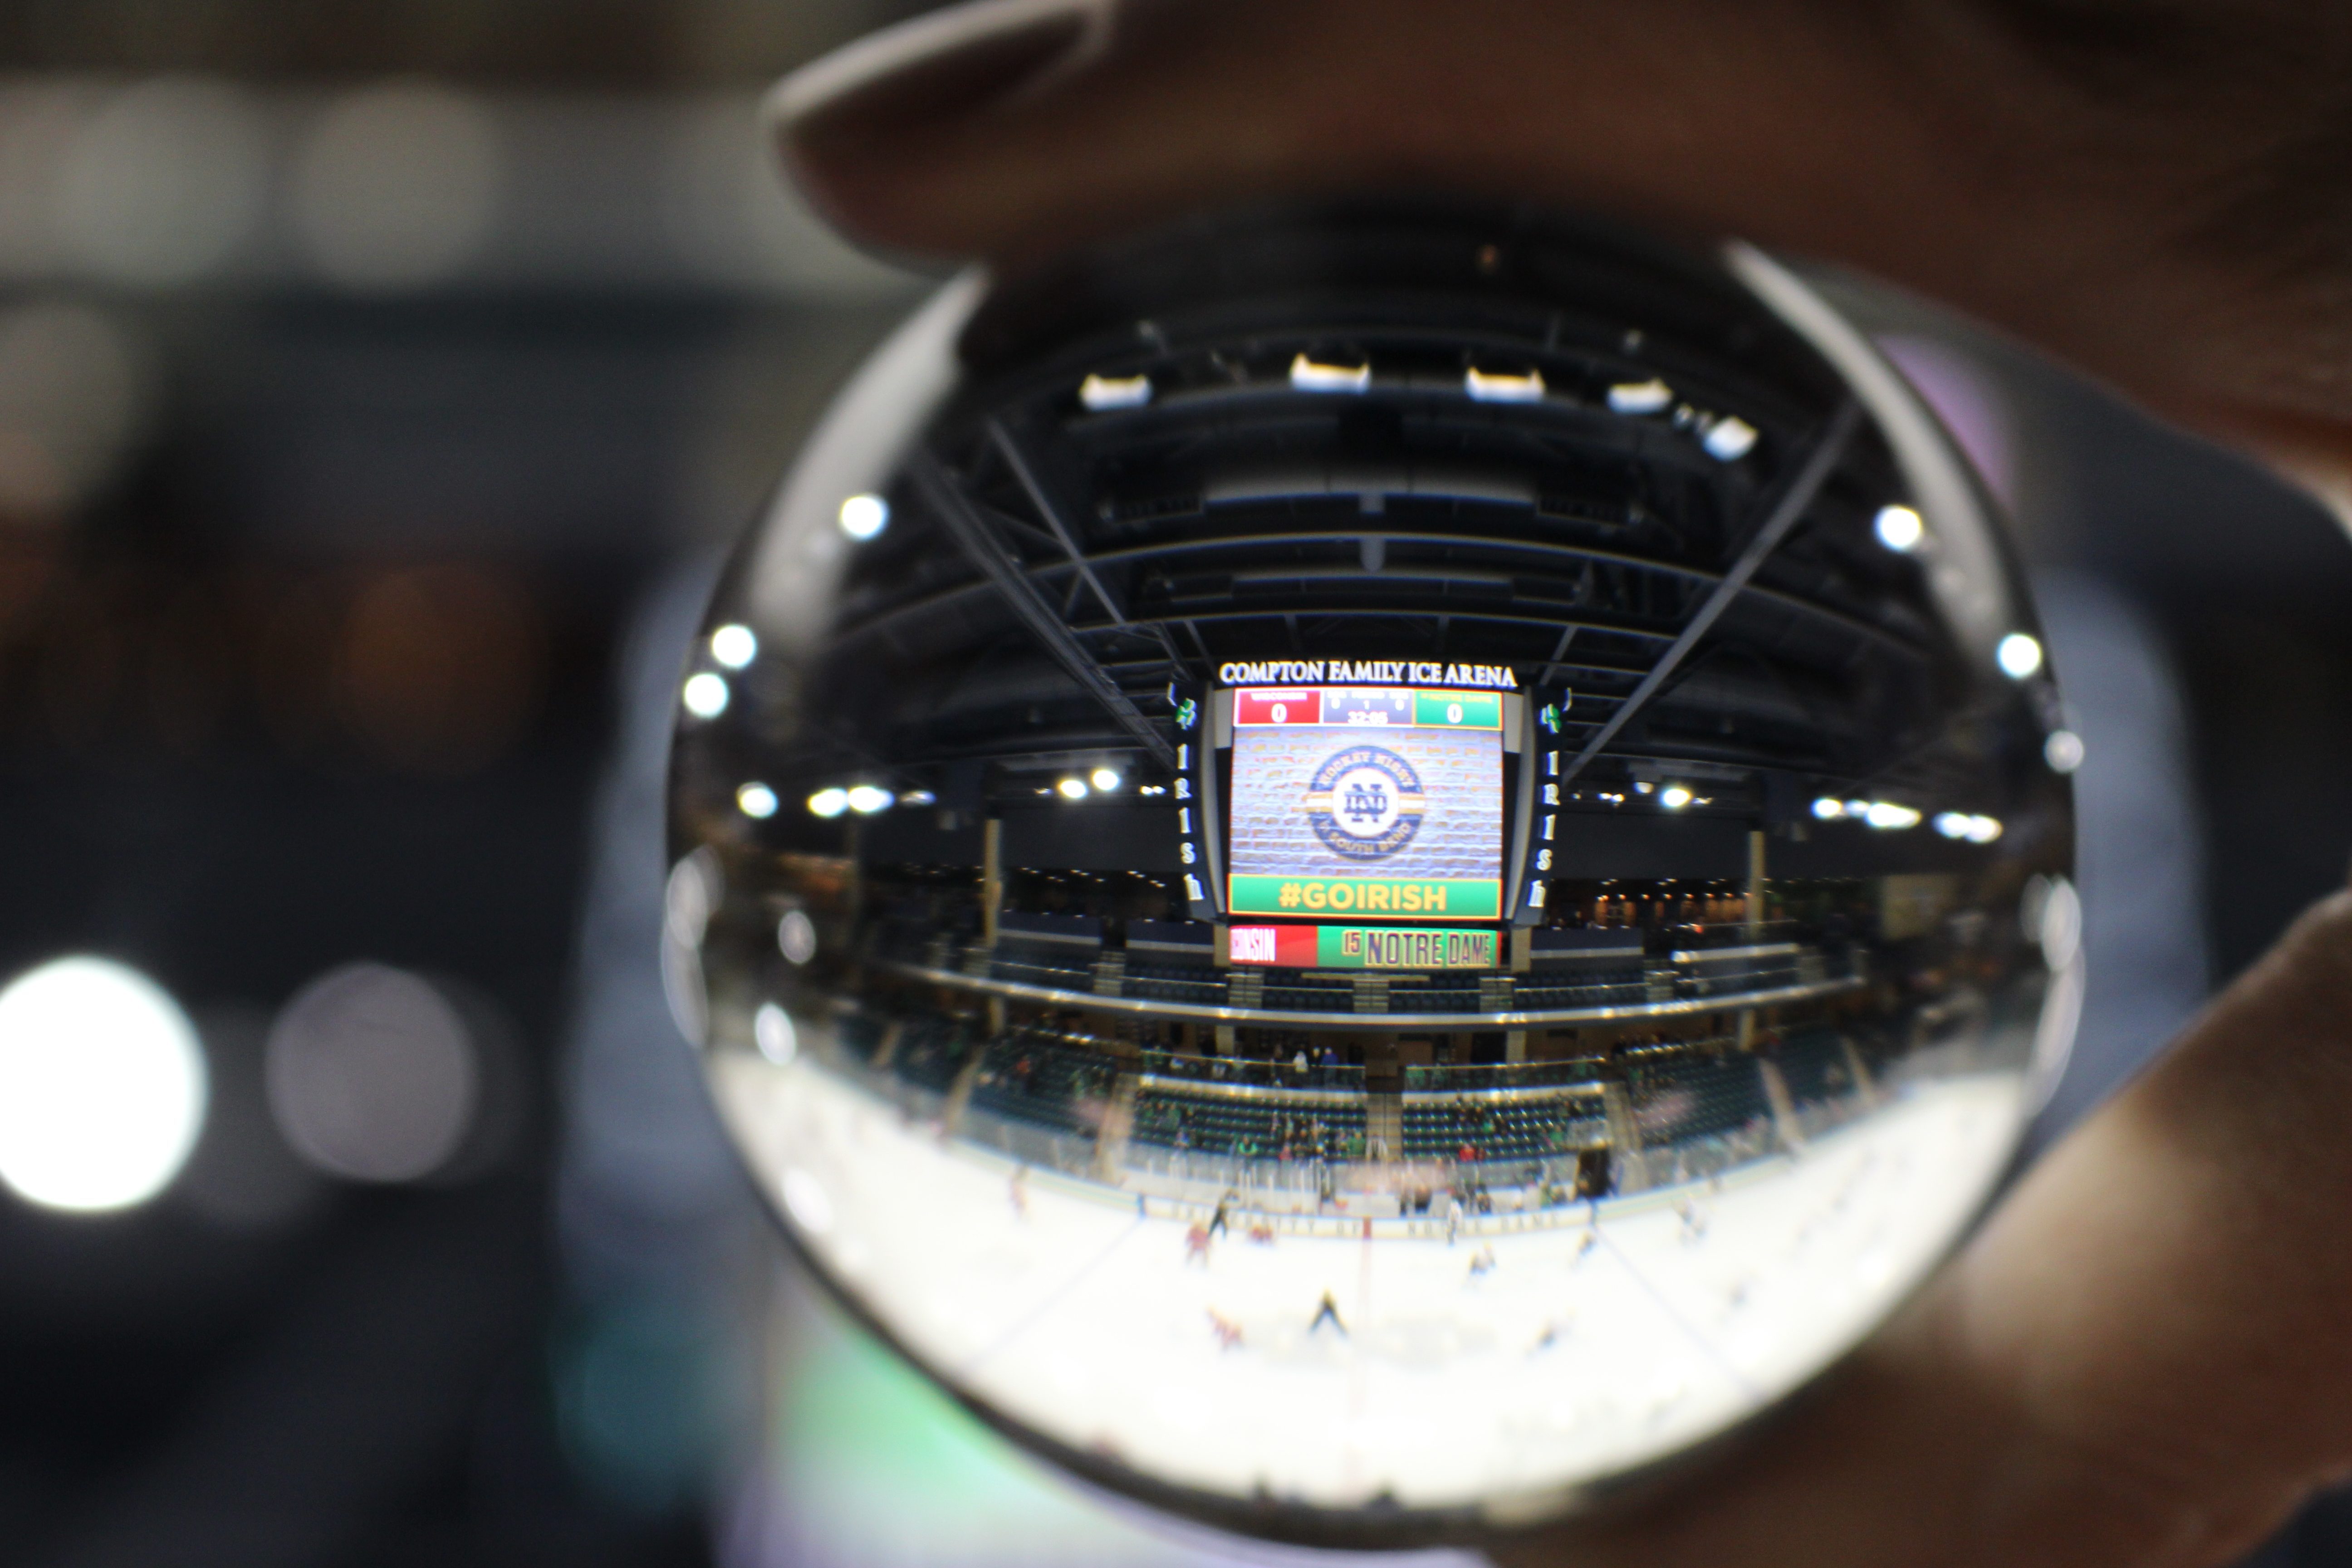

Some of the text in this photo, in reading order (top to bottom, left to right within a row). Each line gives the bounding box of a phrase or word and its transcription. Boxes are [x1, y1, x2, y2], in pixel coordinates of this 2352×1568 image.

[1220, 660, 1518, 689] COMPTON FAMILY ICE ARENA
[1271, 703, 1287, 723] 0
[1447, 703, 1463, 724] 0
[1279, 882, 1446, 911] #GOIRISH
[1342, 929, 1491, 969] 15 NOTRE DAME
